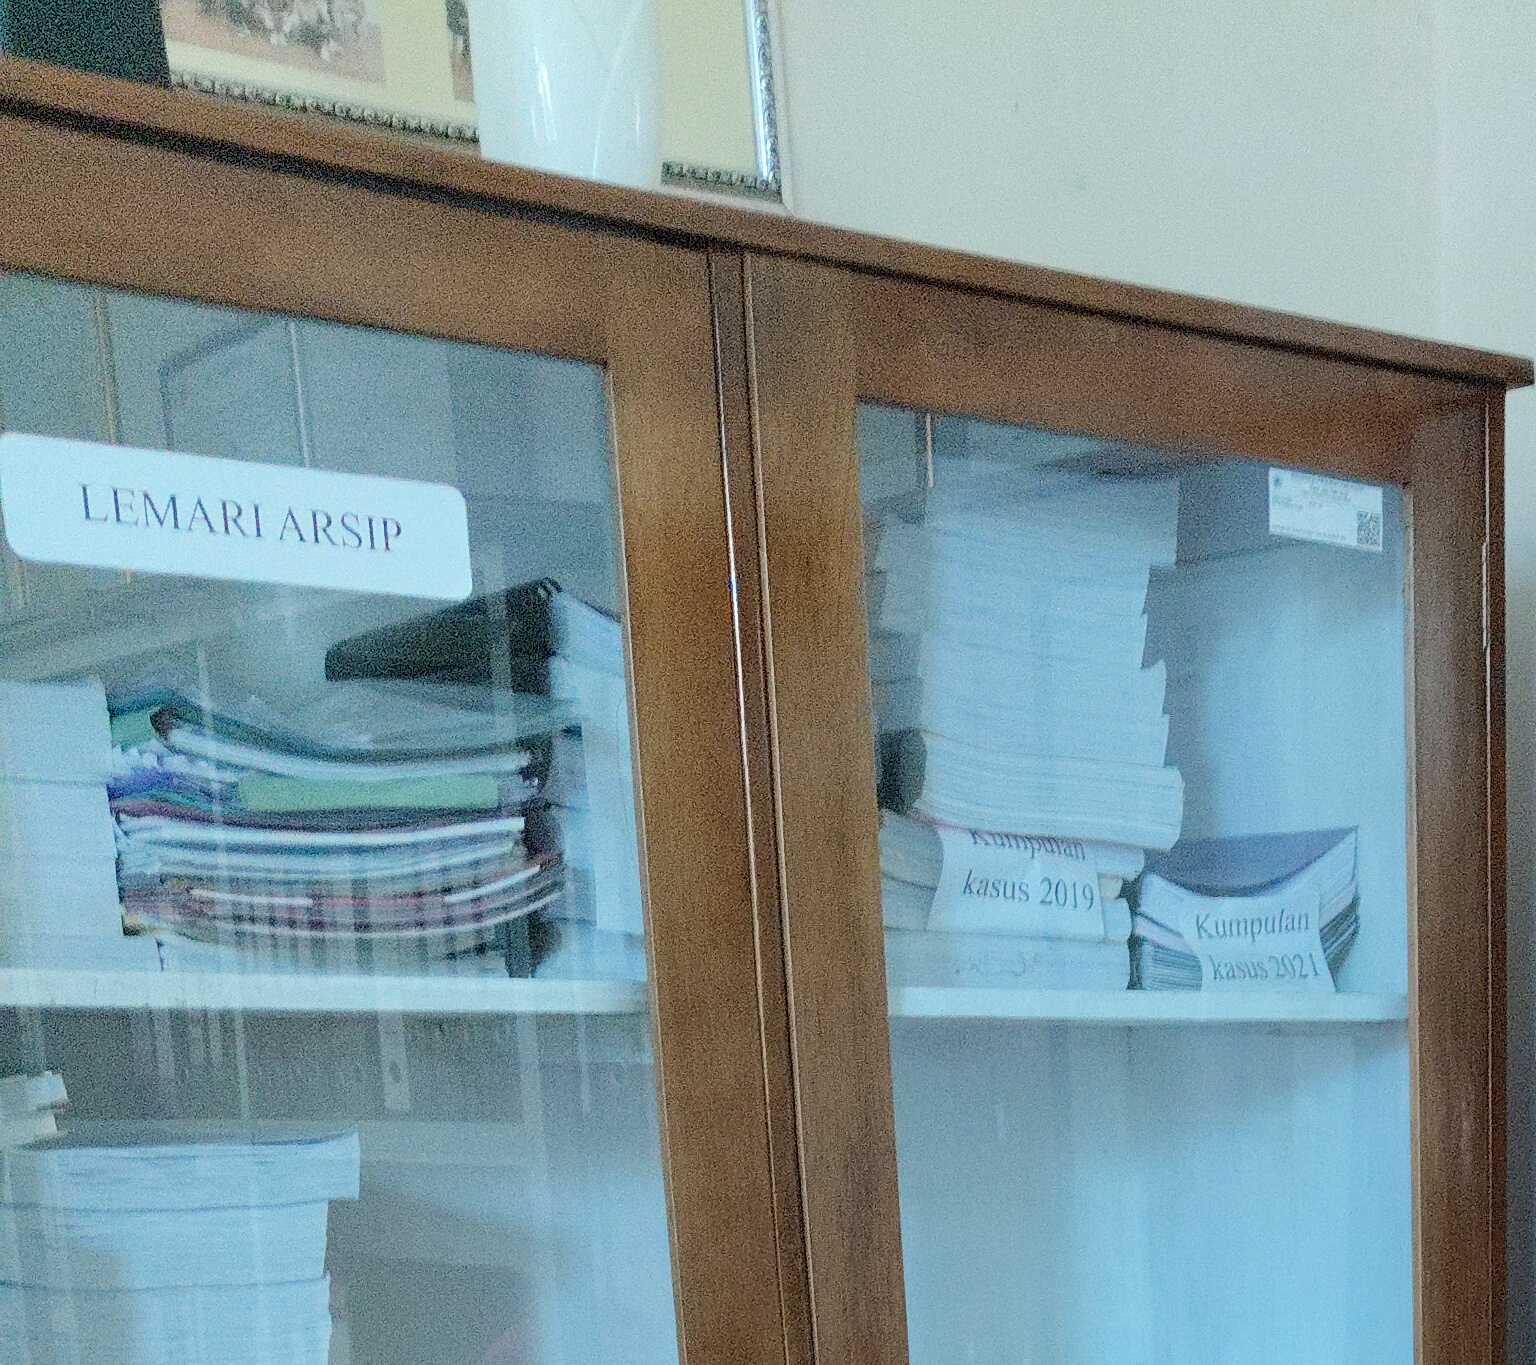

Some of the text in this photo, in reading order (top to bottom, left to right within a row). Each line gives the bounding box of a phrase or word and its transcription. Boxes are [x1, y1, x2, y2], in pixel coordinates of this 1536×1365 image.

[80, 483, 402, 552] LEMARI ARSIP
[962, 868, 1094, 910] kasus 2019
[1195, 908, 1312, 944] Kumpulan
[1208, 952, 1320, 981] kasus 2021
